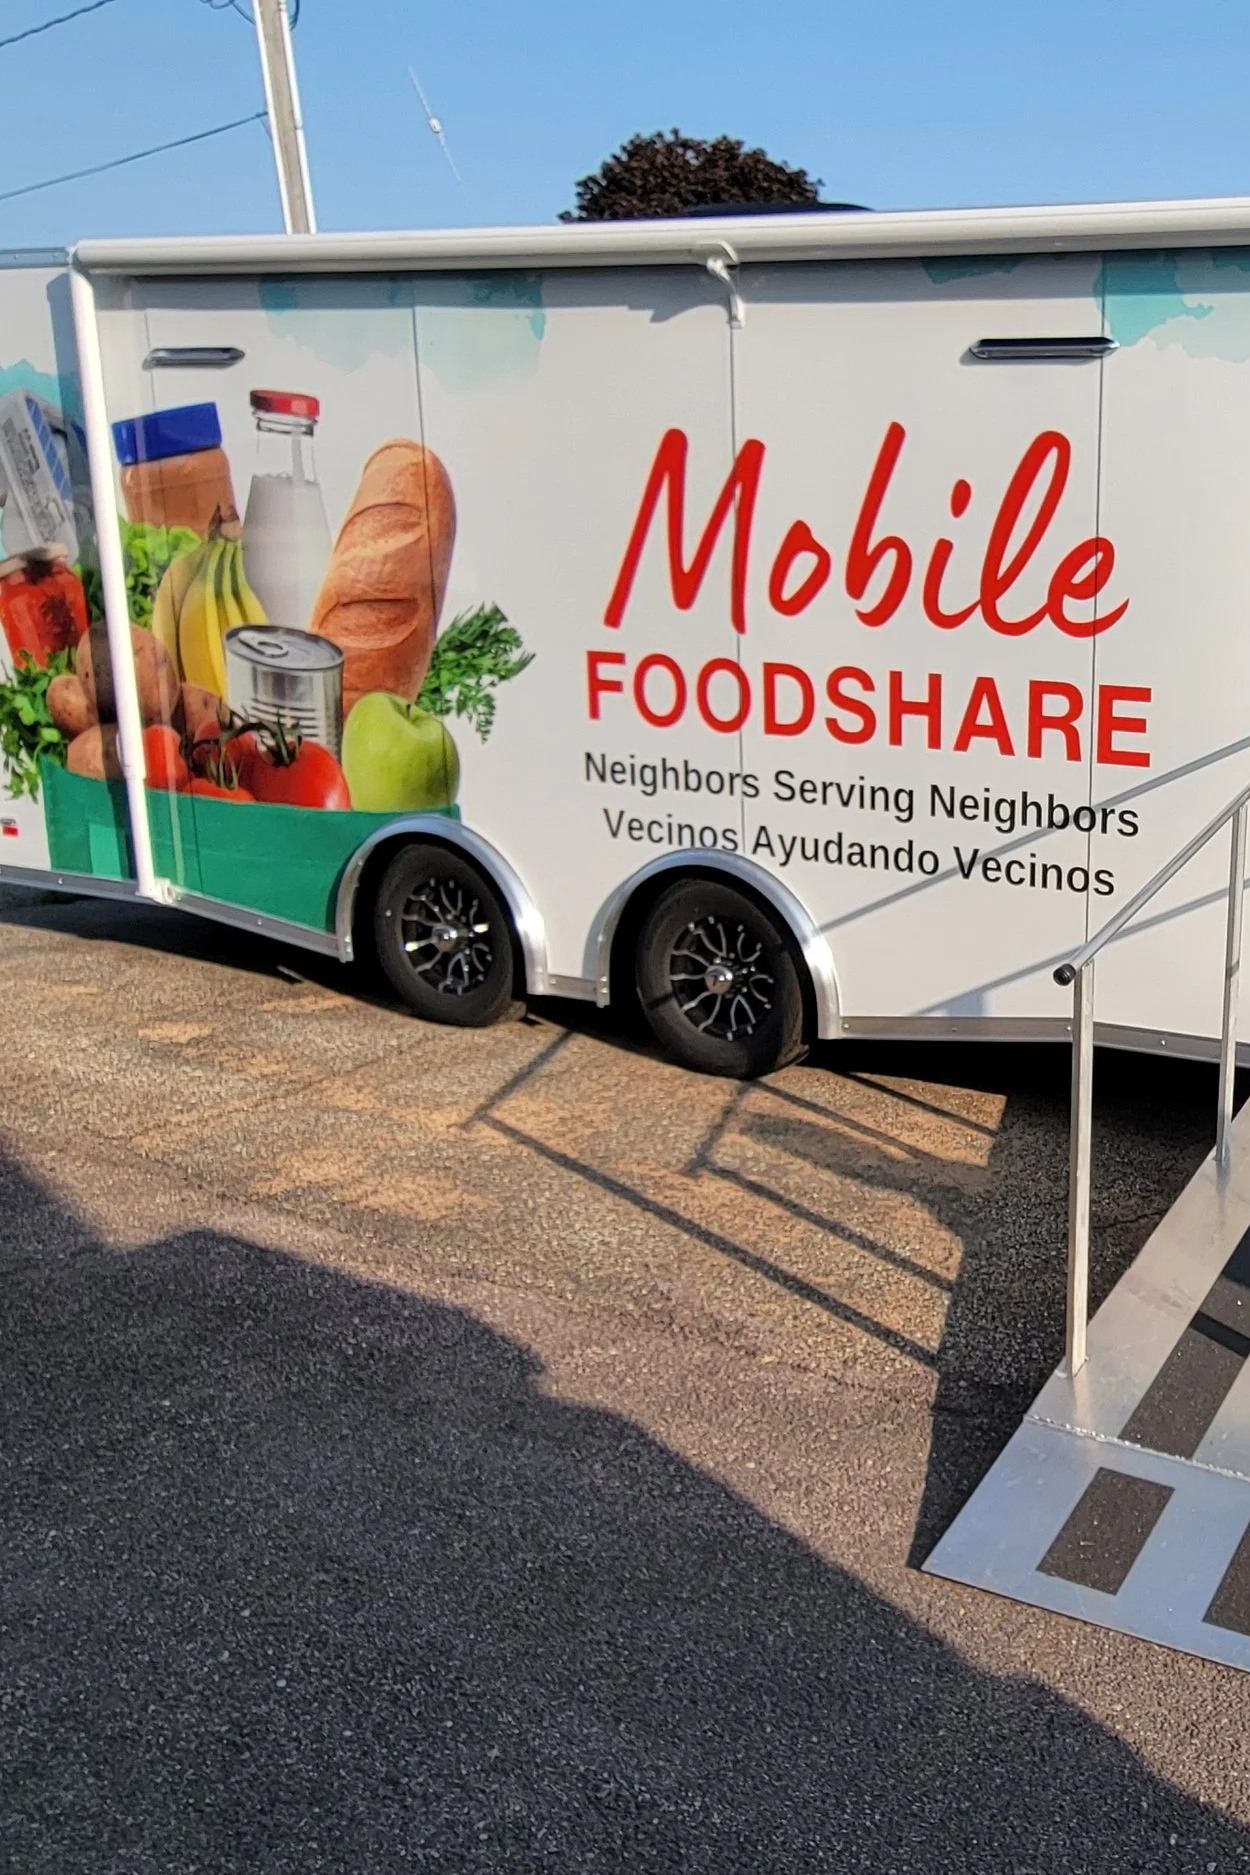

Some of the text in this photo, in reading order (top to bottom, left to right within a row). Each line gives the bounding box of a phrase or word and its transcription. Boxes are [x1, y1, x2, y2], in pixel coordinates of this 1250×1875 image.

[604, 421, 1130, 637] Mobile
[586, 650, 1152, 768] FOODSHARE
[584, 752, 1140, 837] Neighbors Serving Neighbors
[602, 808, 1115, 896] Vecinos Ayudando Vecinos
